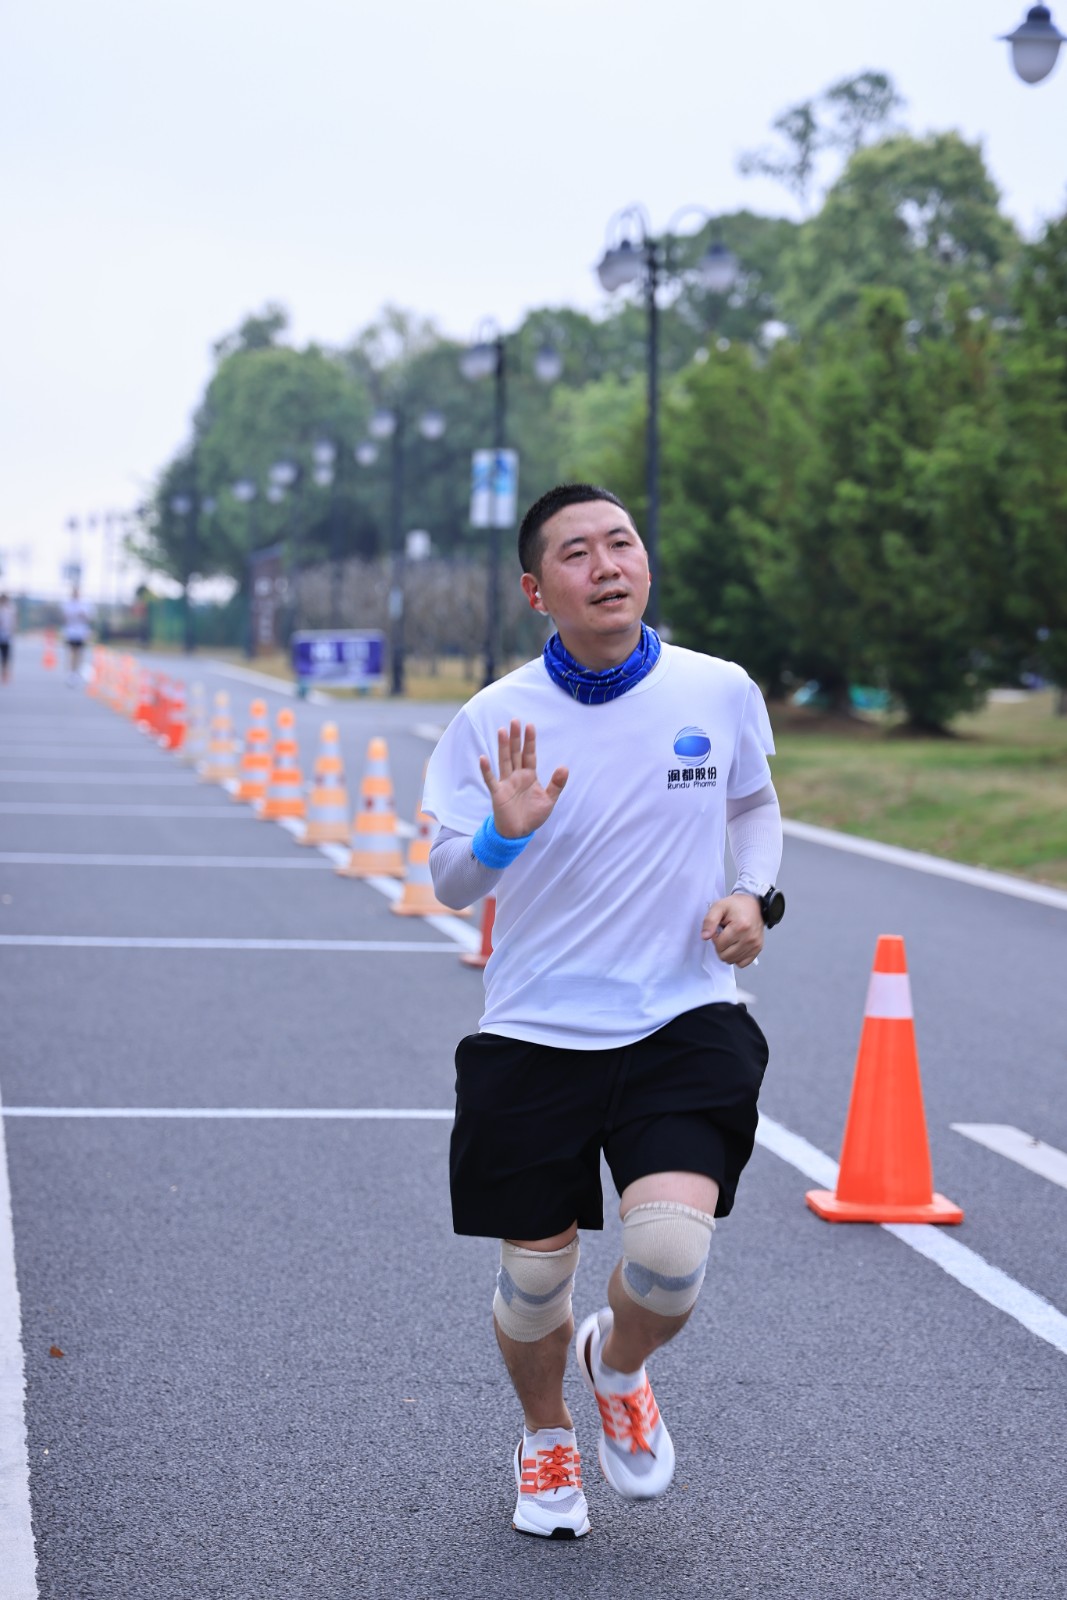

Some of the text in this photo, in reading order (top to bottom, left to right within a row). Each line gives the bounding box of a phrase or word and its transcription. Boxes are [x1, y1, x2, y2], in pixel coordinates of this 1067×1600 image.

[667, 767, 717, 782] 润都股份
[668, 782, 690, 790] Rundu
